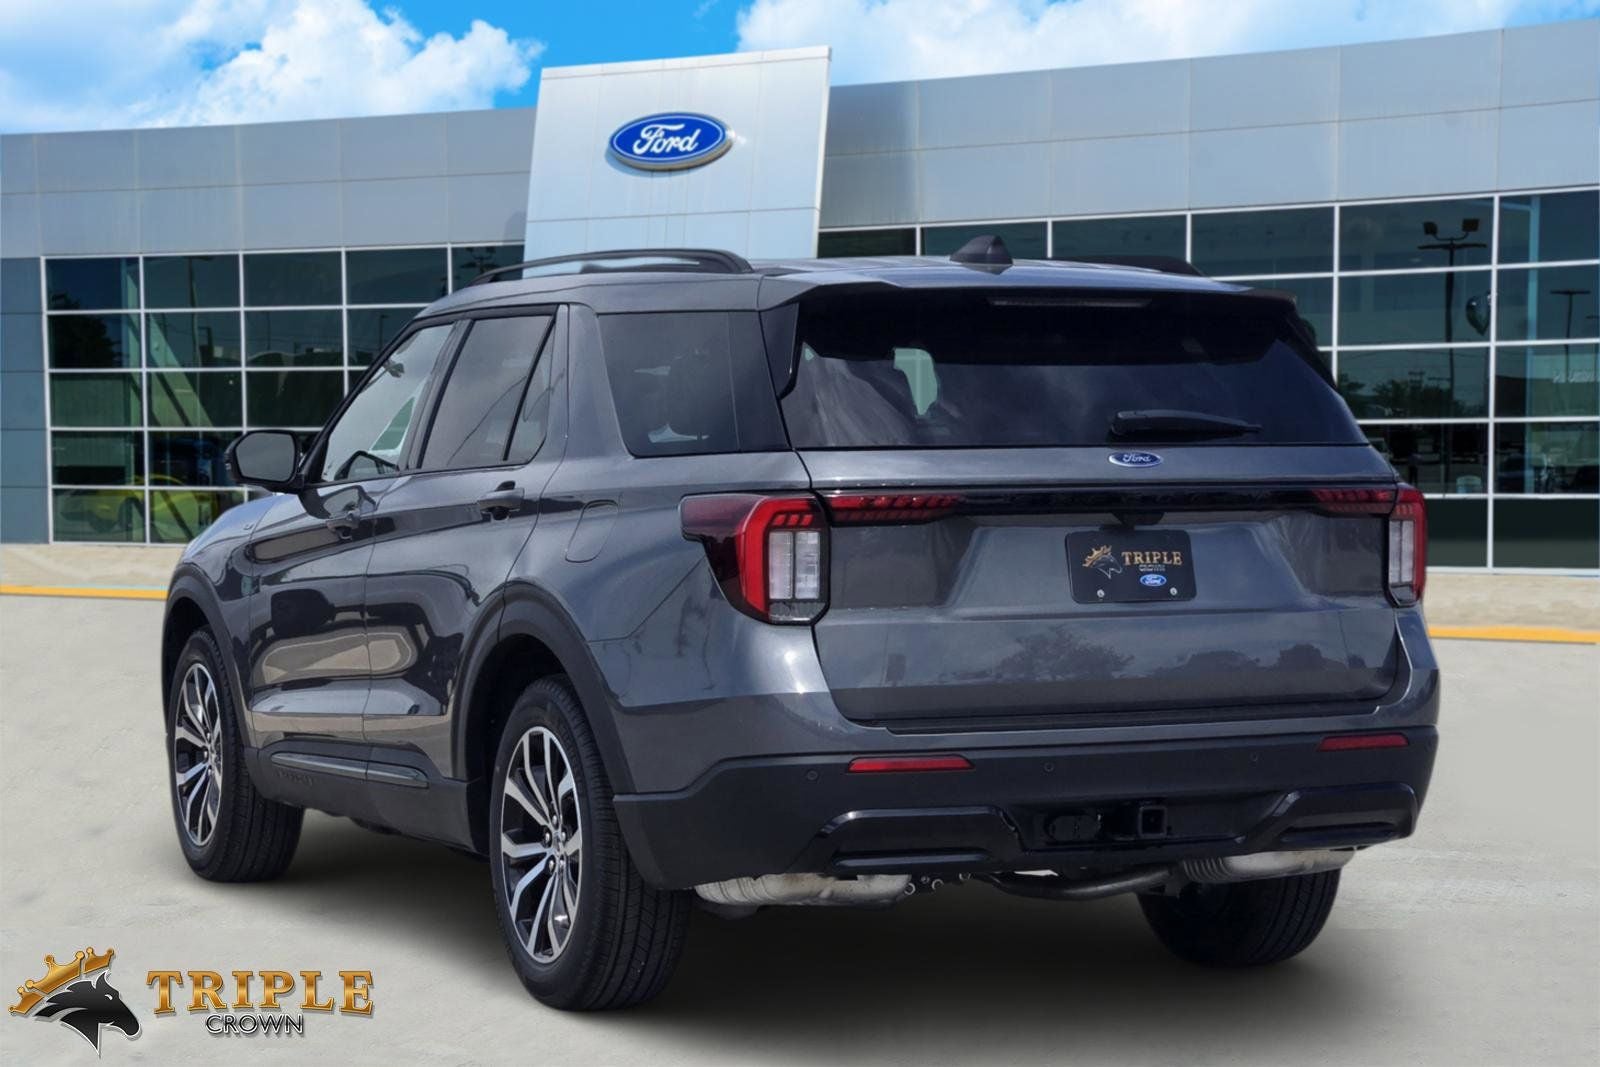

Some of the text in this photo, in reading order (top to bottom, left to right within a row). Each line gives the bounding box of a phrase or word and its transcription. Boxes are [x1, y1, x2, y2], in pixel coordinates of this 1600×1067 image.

[632, 123, 701, 155] Ford
[1122, 453, 1152, 463] Ford
[1121, 551, 1183, 566] TRIPLE
